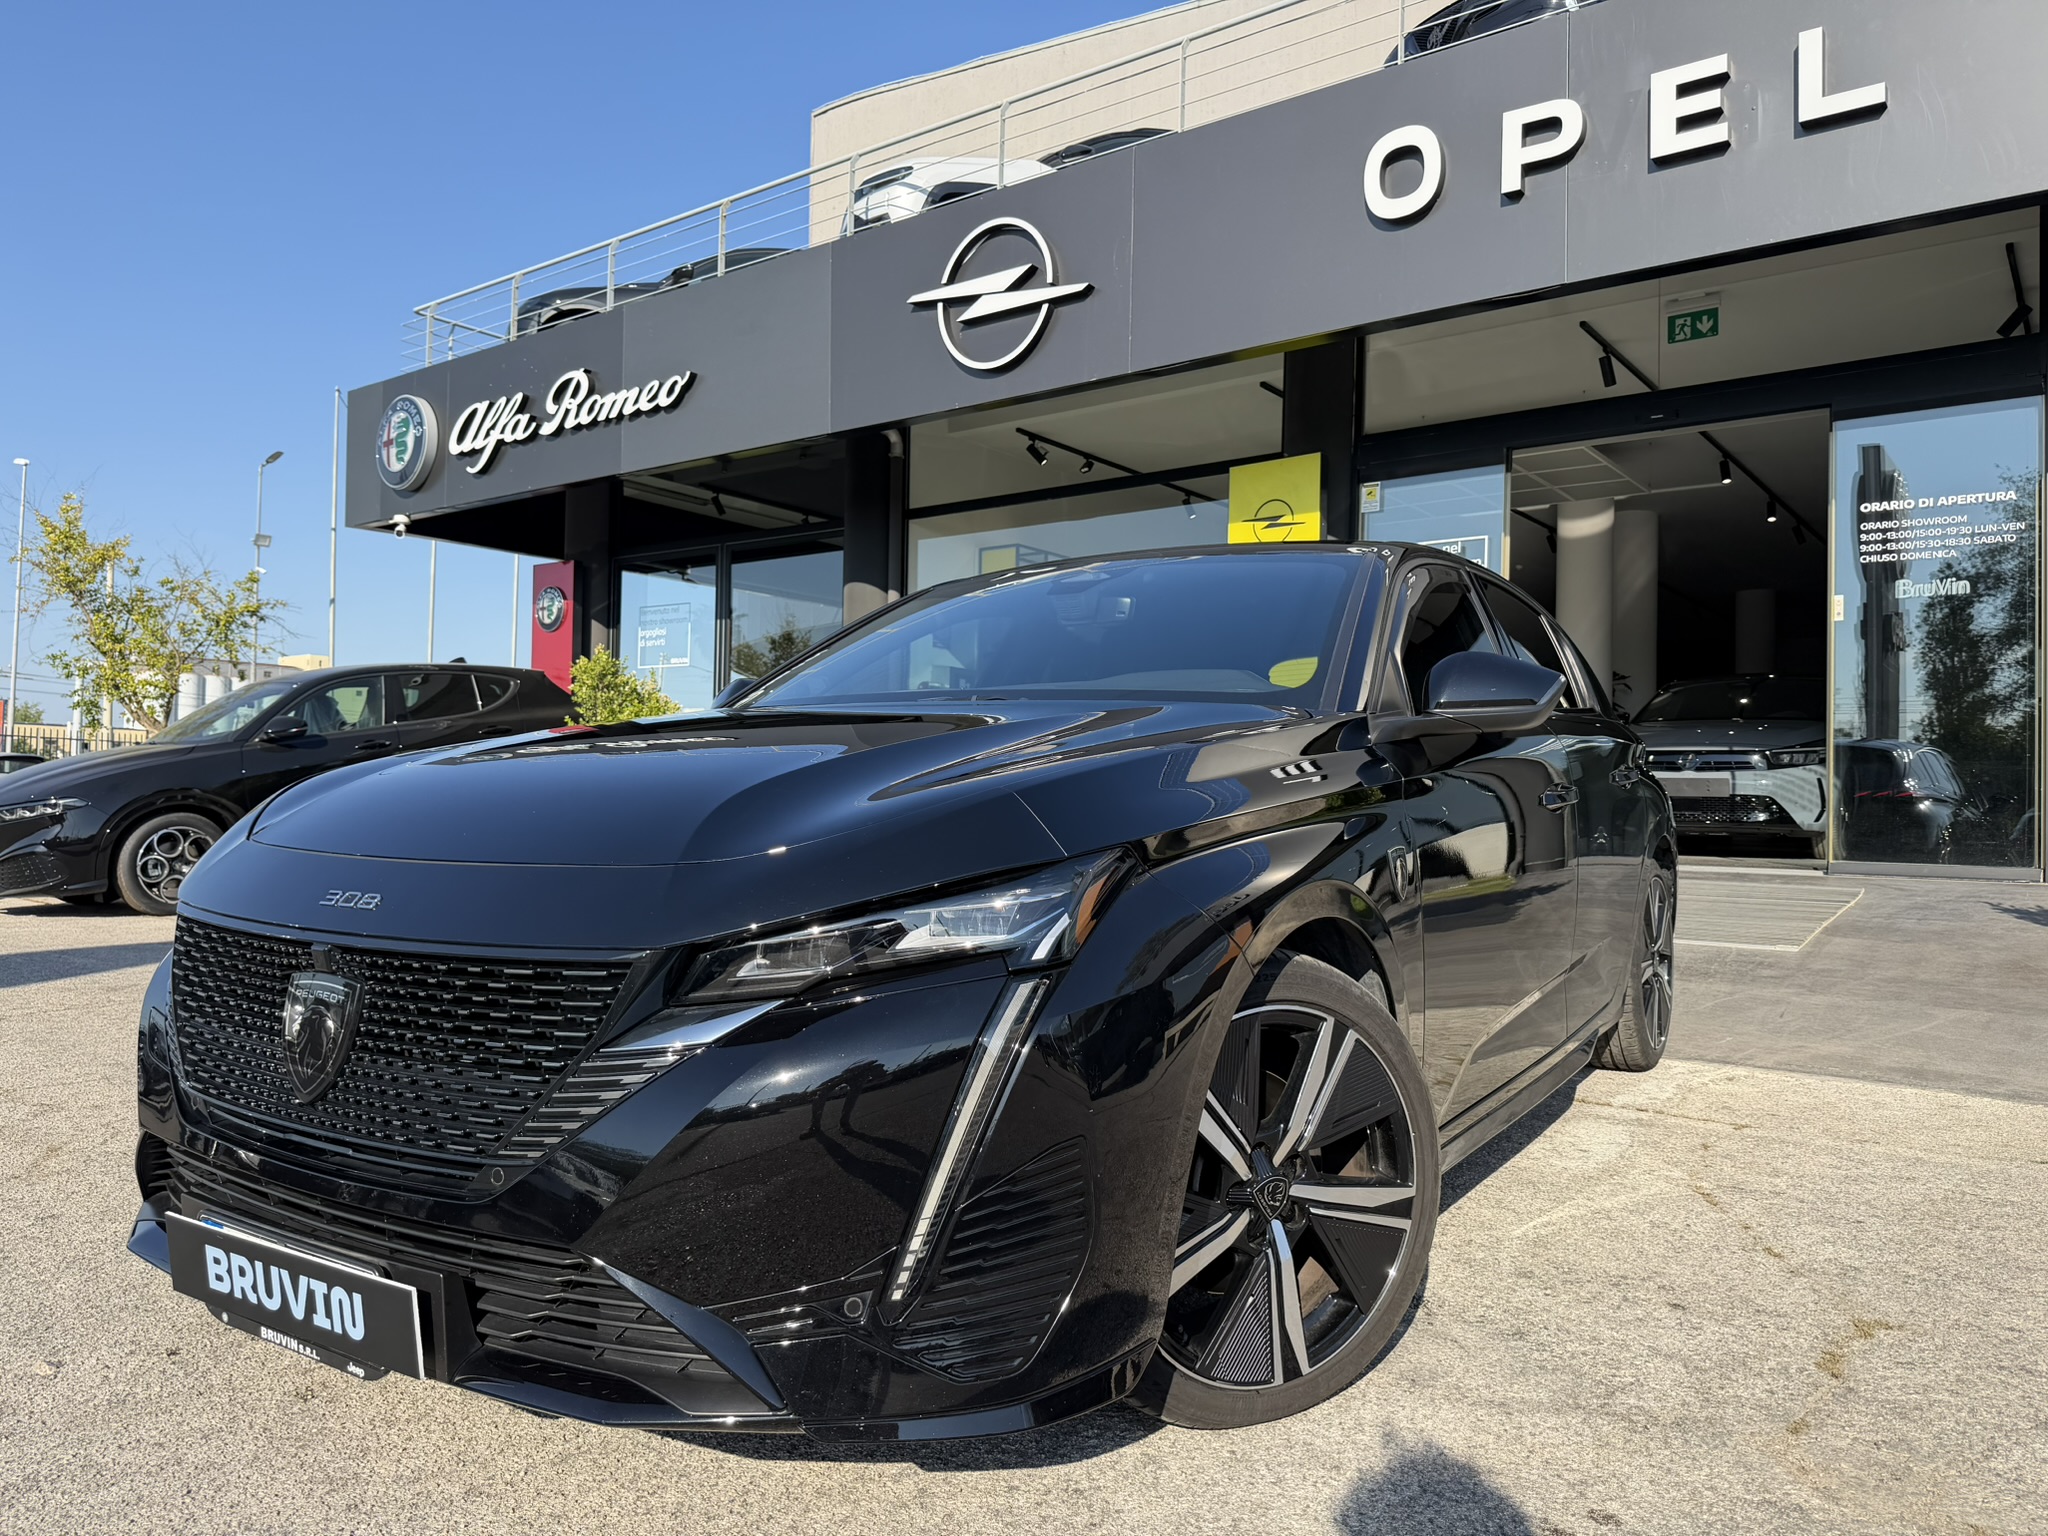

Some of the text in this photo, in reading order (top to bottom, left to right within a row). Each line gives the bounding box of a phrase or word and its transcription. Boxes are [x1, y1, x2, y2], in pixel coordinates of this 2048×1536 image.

[1363, 26, 1887, 221] OPEL
[449, 368, 695, 474] Alfa Romeo
[1860, 490, 2017, 513] ORARIO DI APERTURA
[1860, 514, 1968, 531] ORARIO SHOWROOM
[1974, 522, 2025, 533] LUN-VEN
[1973, 534, 2016, 545] SABATO
[1860, 549, 1957, 563] CHIUSO DOMENICA
[319, 890, 384, 911] 308
[295, 989, 345, 1004] PEUGEOT
[205, 1244, 365, 1341] BRUVIN
[260, 1326, 298, 1351] BRUVIN
[347, 1362, 365, 1378] Jeep
